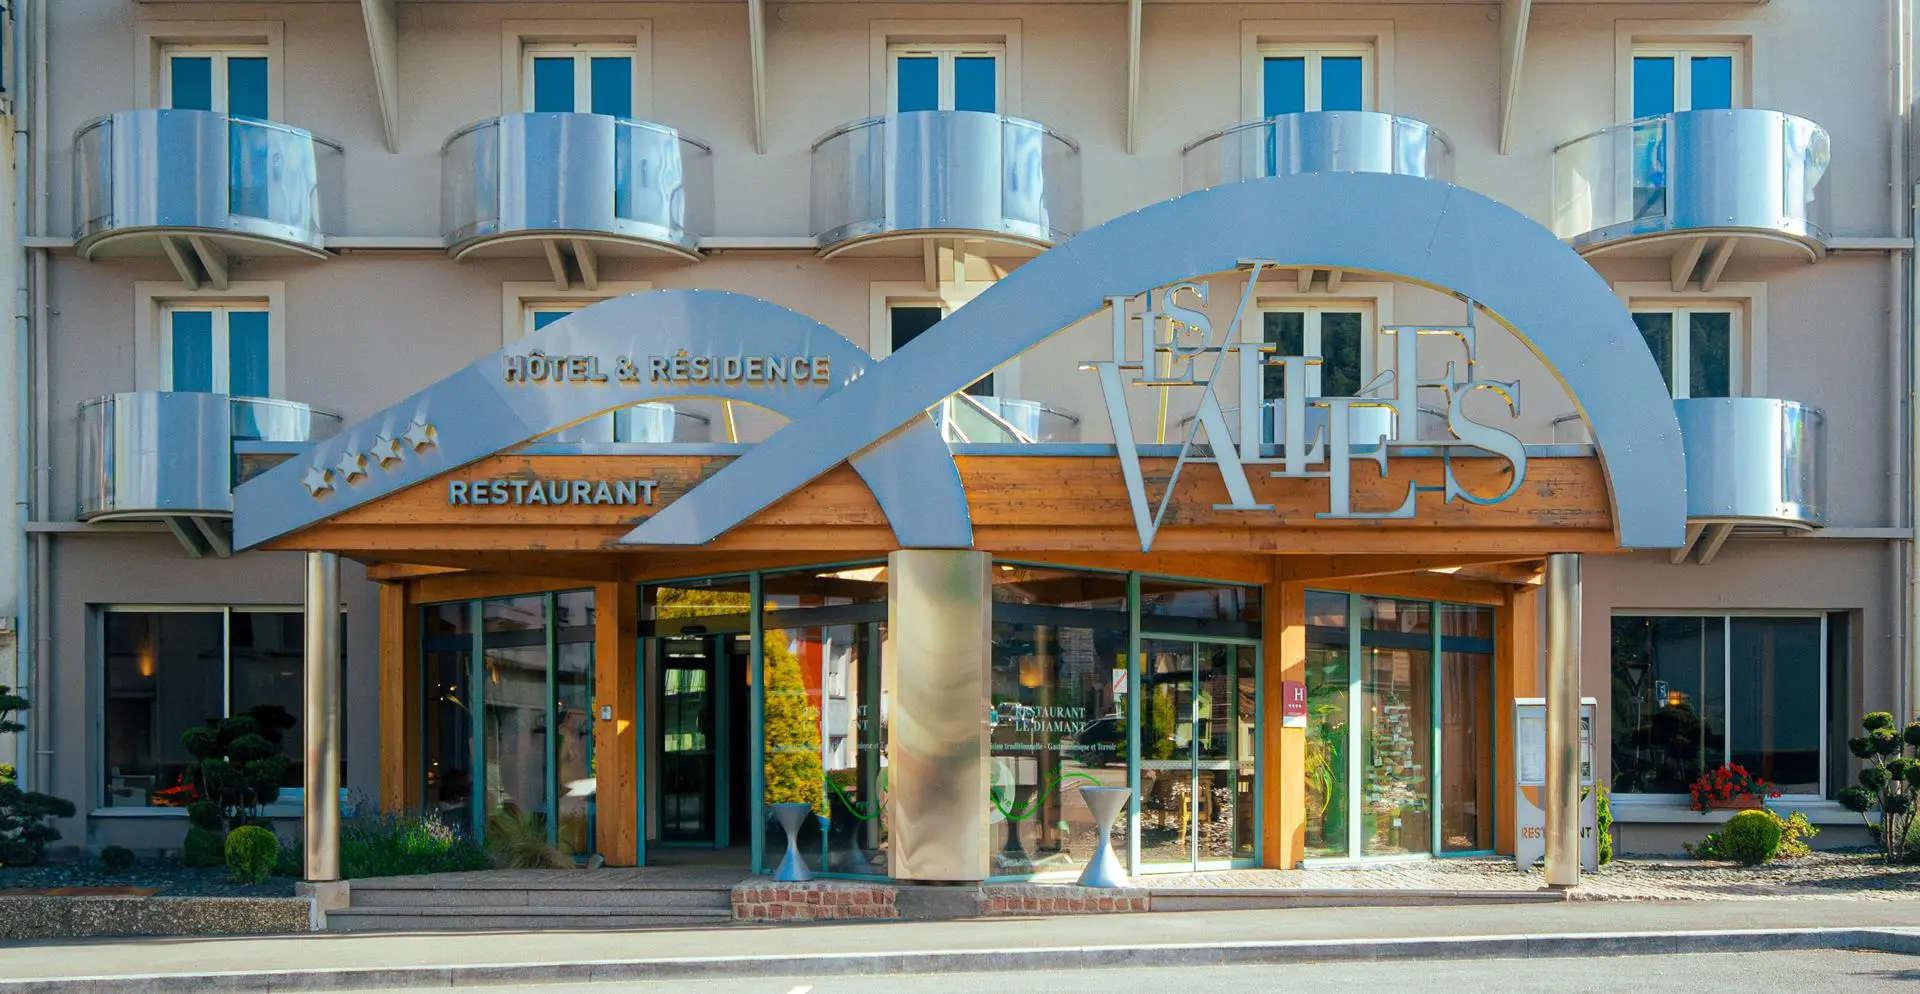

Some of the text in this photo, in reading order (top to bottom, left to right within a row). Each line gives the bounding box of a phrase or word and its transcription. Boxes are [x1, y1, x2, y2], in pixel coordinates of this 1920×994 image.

[1103, 281, 1213, 387] LES
[502, 349, 830, 383] HÔTEL & RÉSIDENCE
[1078, 258, 1527, 553] VALLÉES
[448, 480, 657, 505] RESTAURANT
[1294, 687, 1304, 701] H
[1015, 706, 1085, 718] RESTAURANT
[1015, 721, 1086, 732] LE DIAMANT
[1520, 827, 1591, 839] RESTNT
